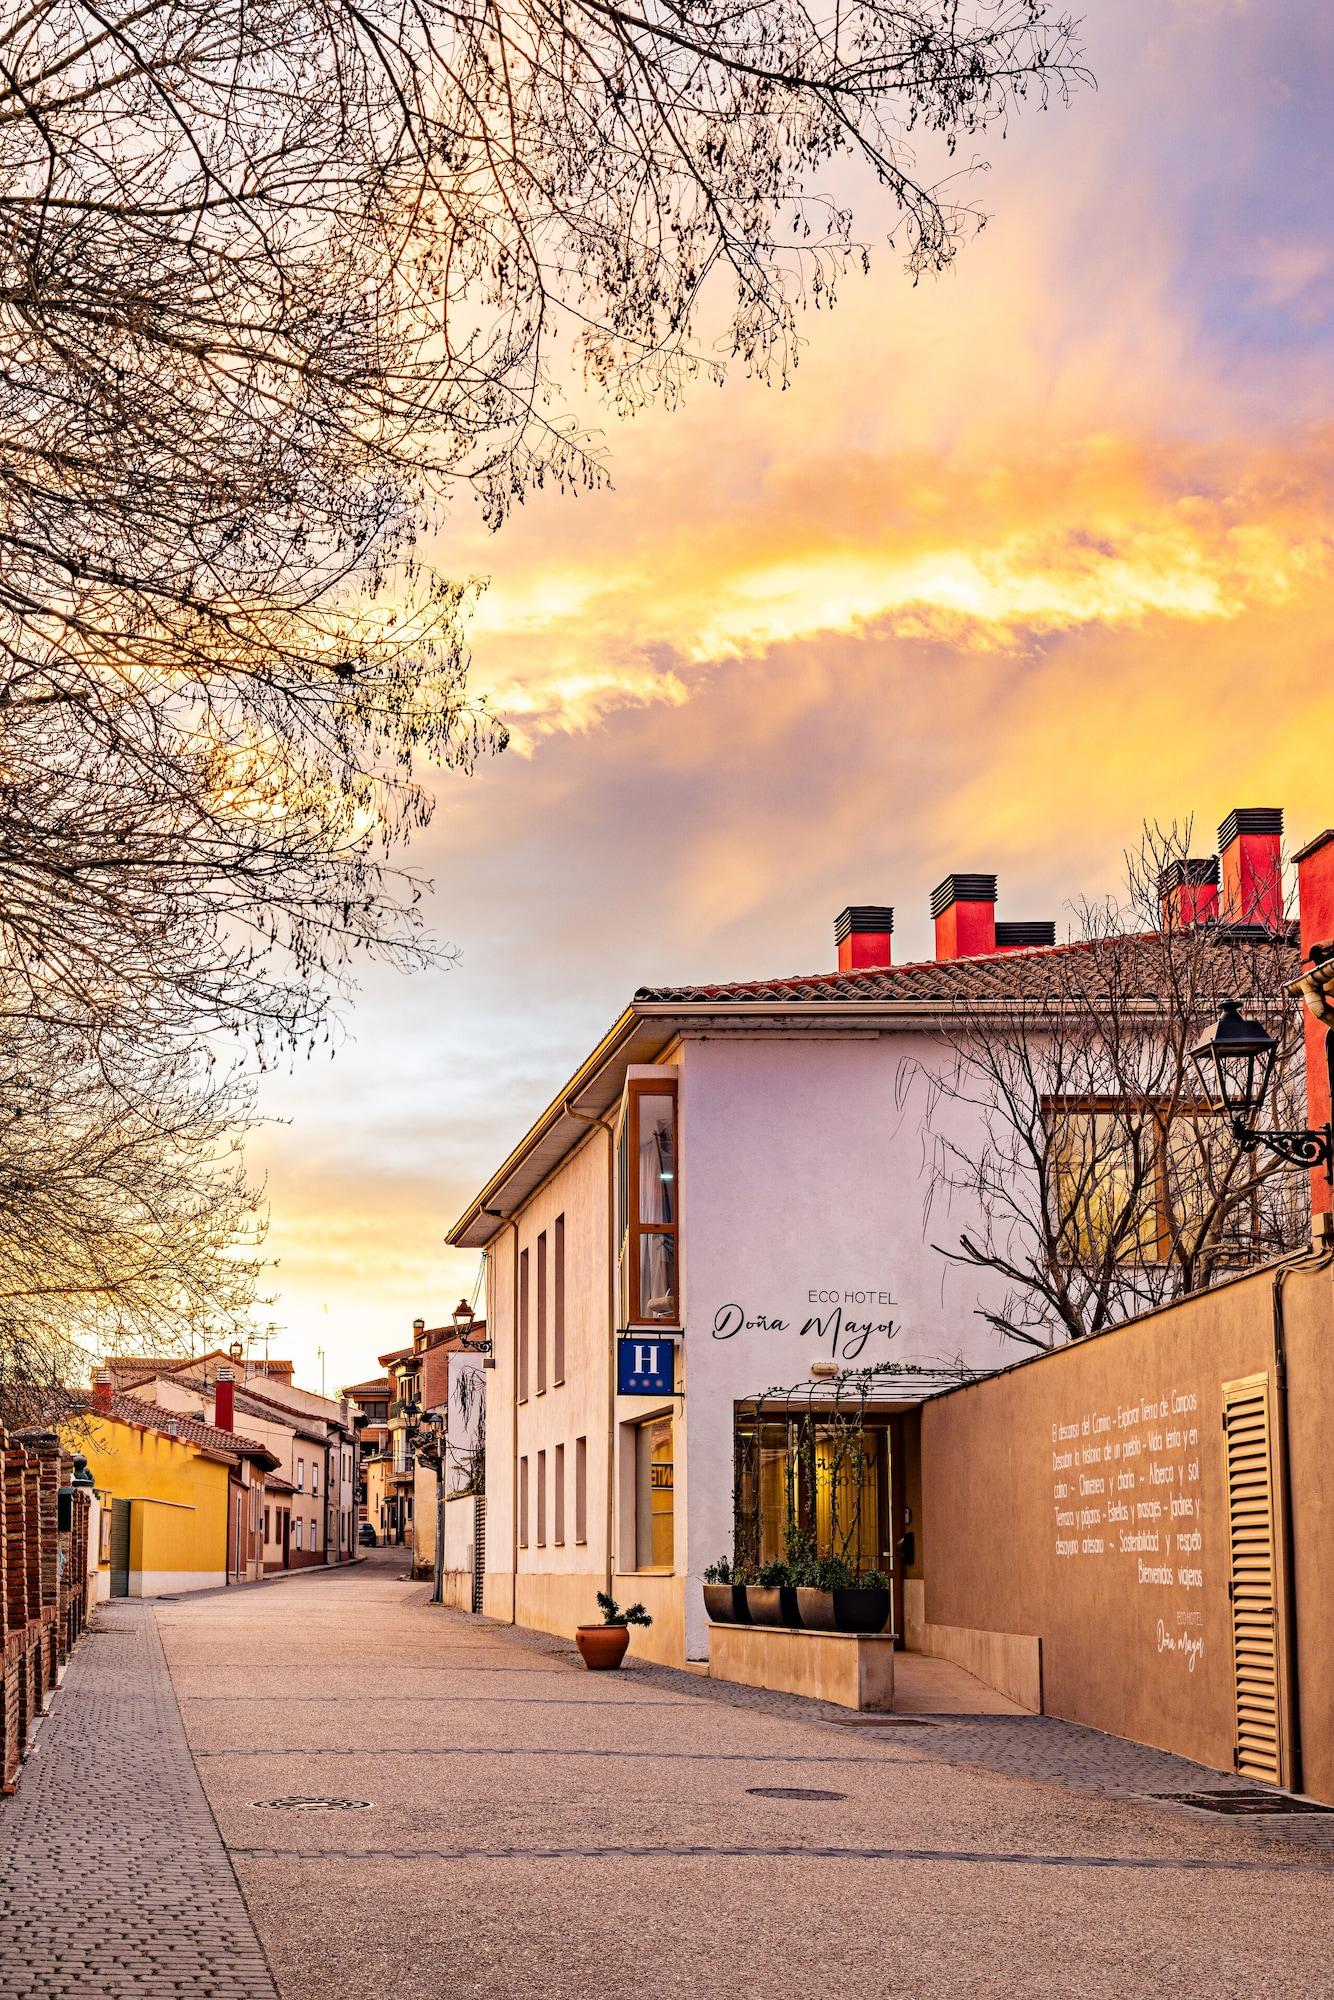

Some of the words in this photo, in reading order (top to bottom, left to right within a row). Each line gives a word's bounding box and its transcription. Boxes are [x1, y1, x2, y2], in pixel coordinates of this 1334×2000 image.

[808, 1290, 840, 1303] ECO
[844, 1291, 898, 1305] HOTEL
[712, 1303, 790, 1340] Doña
[799, 1307, 901, 1360] Mayor
[632, 1344, 660, 1374] H
[1082, 1414, 1090, 1436] del
[1141, 1398, 1158, 1420] Tierra
[1160, 1394, 1168, 1416] de
[1172, 1389, 1197, 1417] Campos
[1104, 1439, 1112, 1462] de
[1114, 1443, 1120, 1458] un
[1122, 1435, 1141, 1461] pueblo
[1148, 1428, 1162, 1450] Vida
[1183, 1430, 1187, 1451] y
[1189, 1429, 1197, 1445] en
[1109, 1476, 1113, 1496] y
[1149, 1462, 1173, 1485] Alberca
[1178, 1466, 1183, 1486] y
[1188, 1457, 1199, 1481] sol
[1131, 1504, 1135, 1524] y
[1194, 1499, 1200, 1519] y
[1165, 1534, 1170, 1557] y
[1177, 1528, 1202, 1557] respeto
[1138, 1558, 1173, 1585] Bienvenidos
[1178, 1564, 1202, 1590] viajeros
